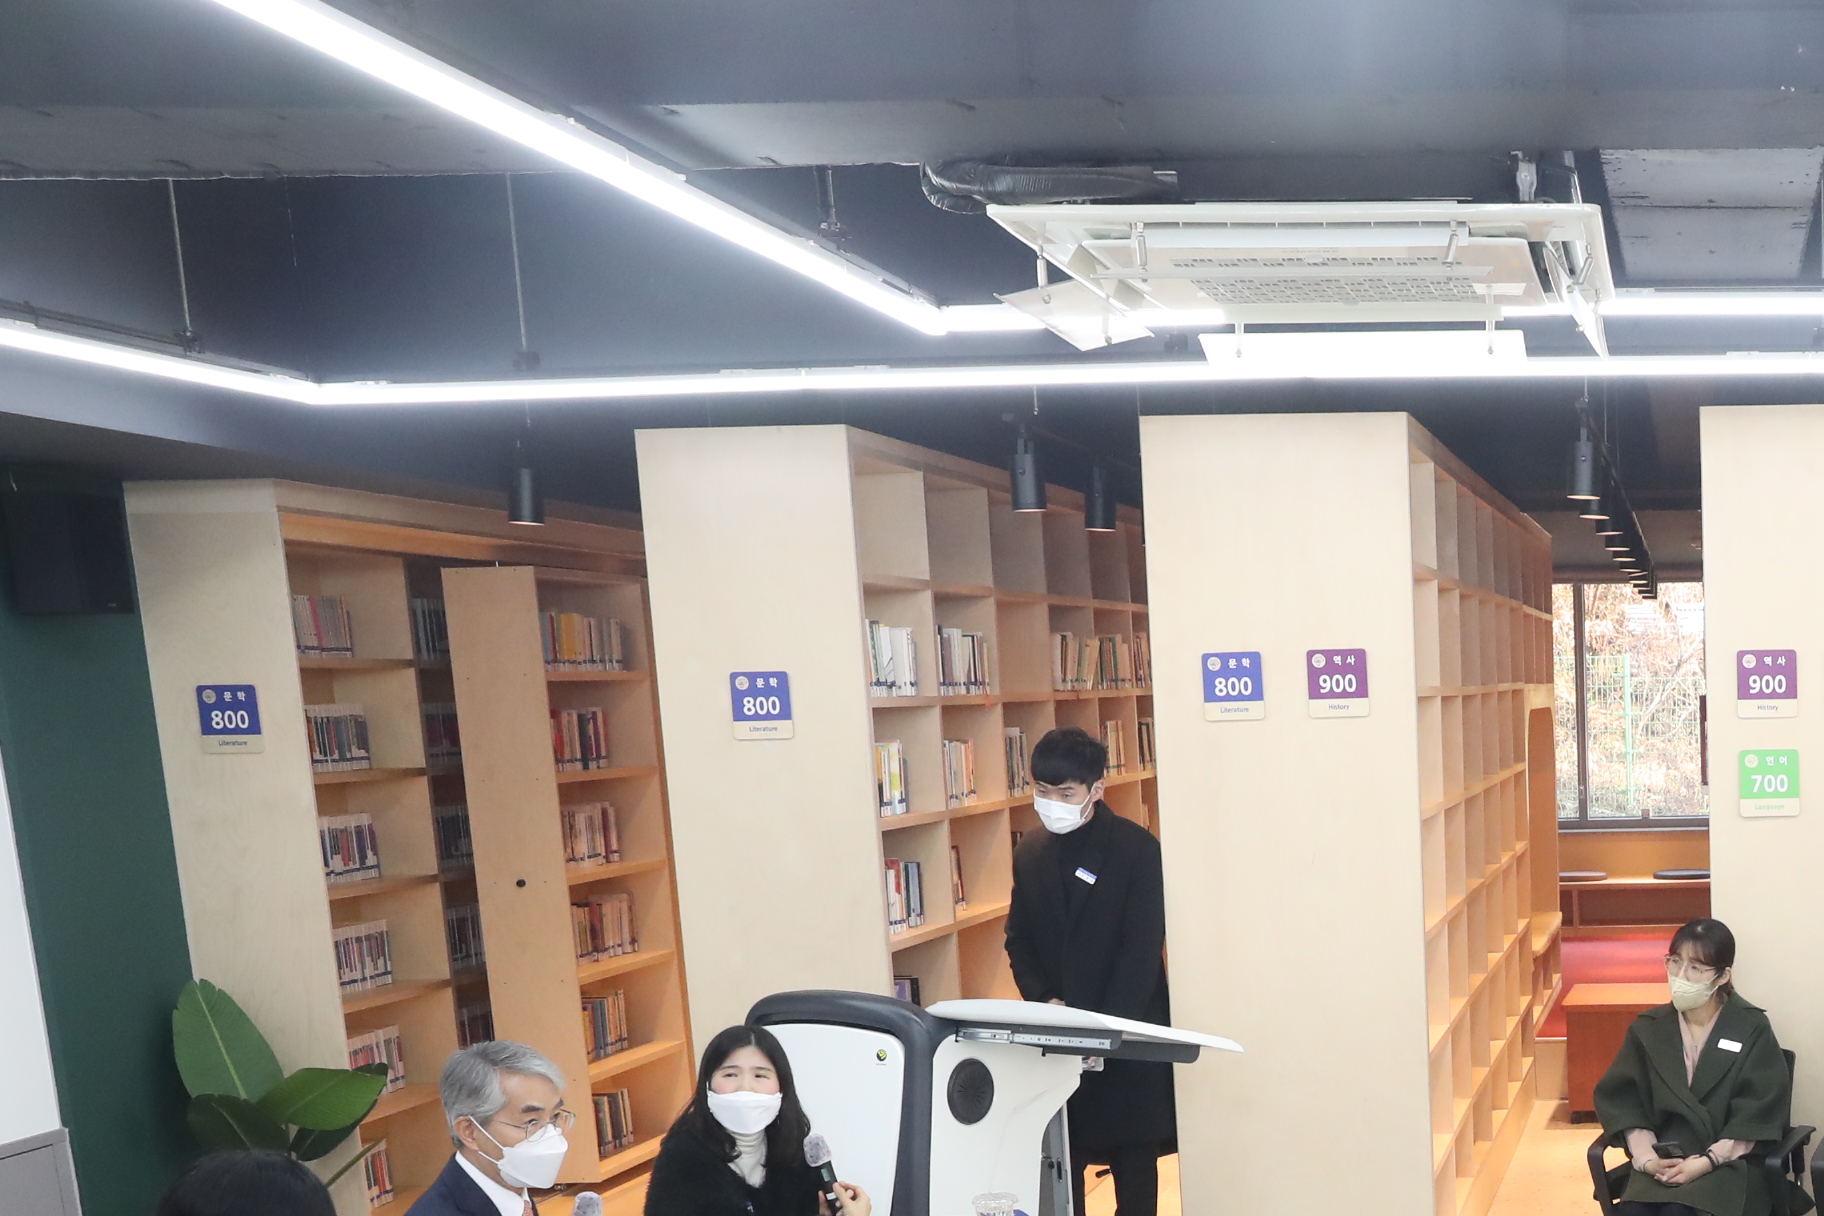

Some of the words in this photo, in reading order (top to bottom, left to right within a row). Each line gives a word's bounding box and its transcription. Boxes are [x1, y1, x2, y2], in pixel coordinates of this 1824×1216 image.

[1228, 658, 1250, 669] 문학
[1333, 655, 1355, 666] 역사
[1763, 656, 1786, 666] 역사
[1214, 677, 1252, 697] 800
[1318, 674, 1357, 693] 900
[1749, 674, 1787, 694] 900
[743, 696, 780, 716] 800
[211, 710, 249, 729] 800
[1765, 756, 1787, 766] 언어
[1751, 774, 1789, 793] 700
